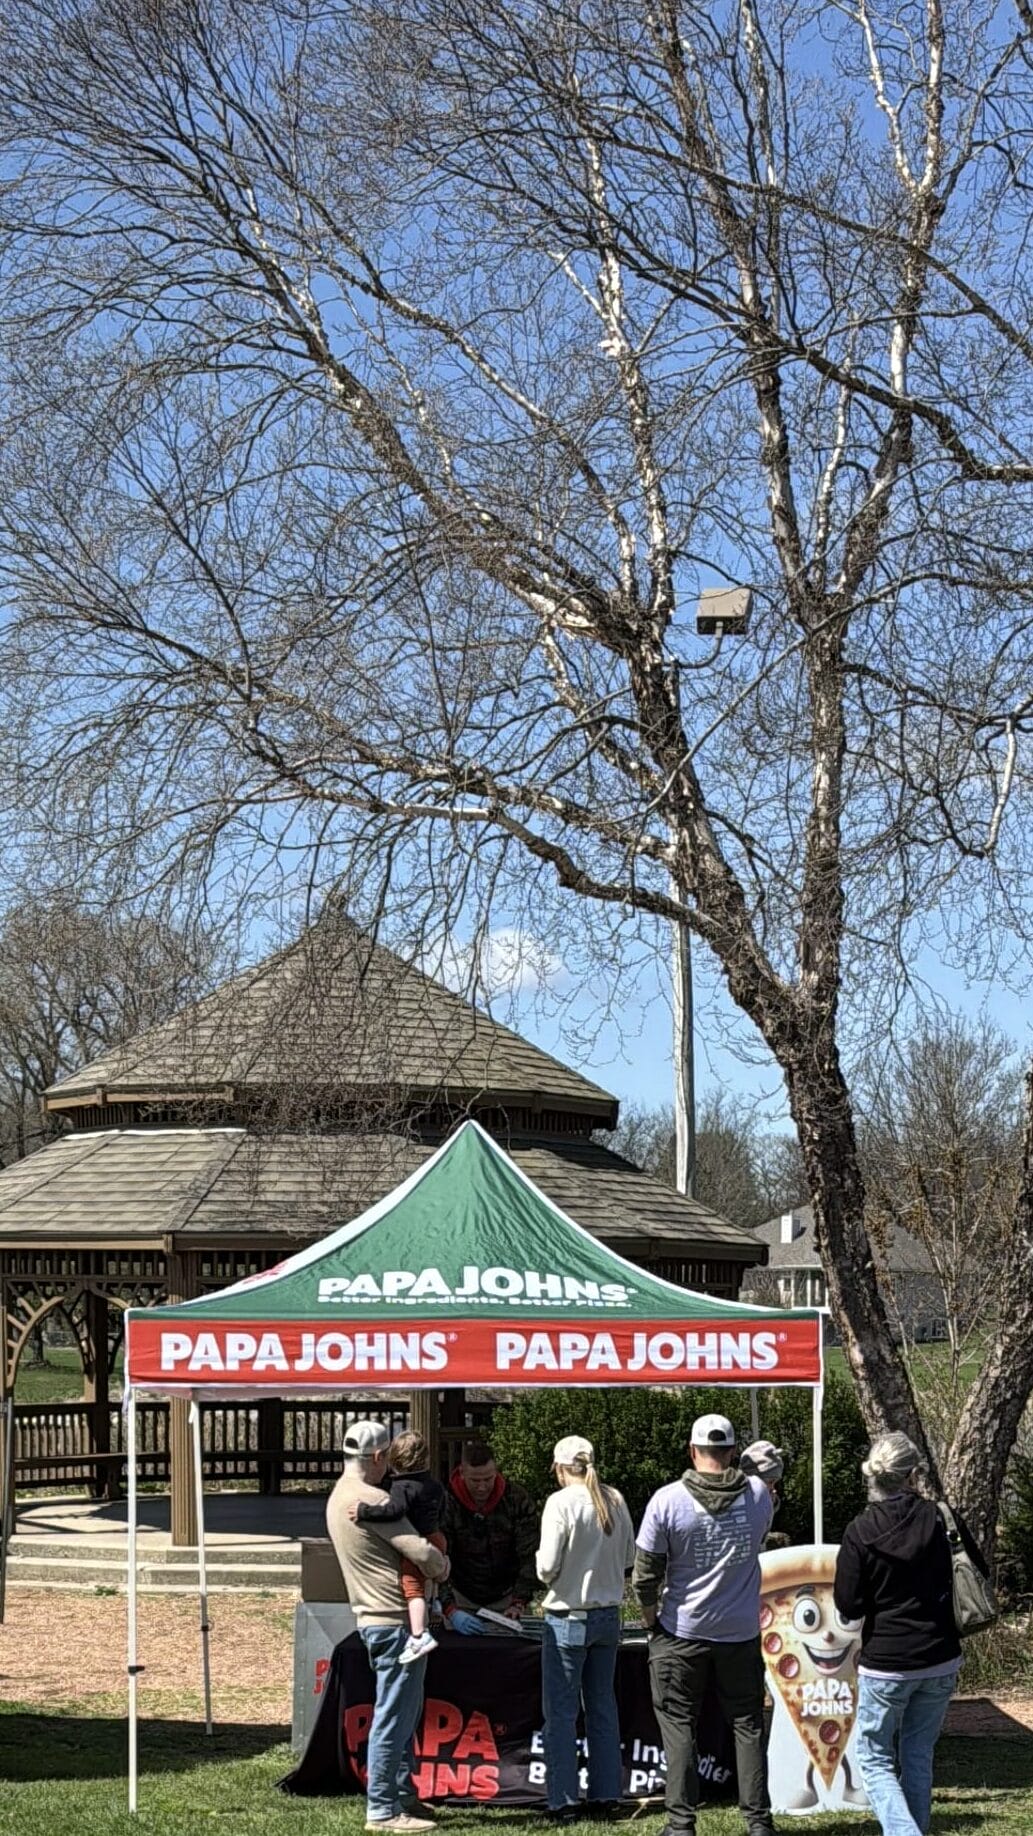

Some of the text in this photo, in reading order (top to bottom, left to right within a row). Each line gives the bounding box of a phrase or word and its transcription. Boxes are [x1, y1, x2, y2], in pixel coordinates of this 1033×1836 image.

[318, 1268, 452, 1297] PAPA
[455, 1266, 629, 1302] JOHNS
[160, 1331, 449, 1371] PAPA JOHNS
[496, 1331, 779, 1371] PAPA JOHNS
[800, 1677, 853, 1717] PAPA JOHNS
[344, 1698, 500, 1761] PPA
